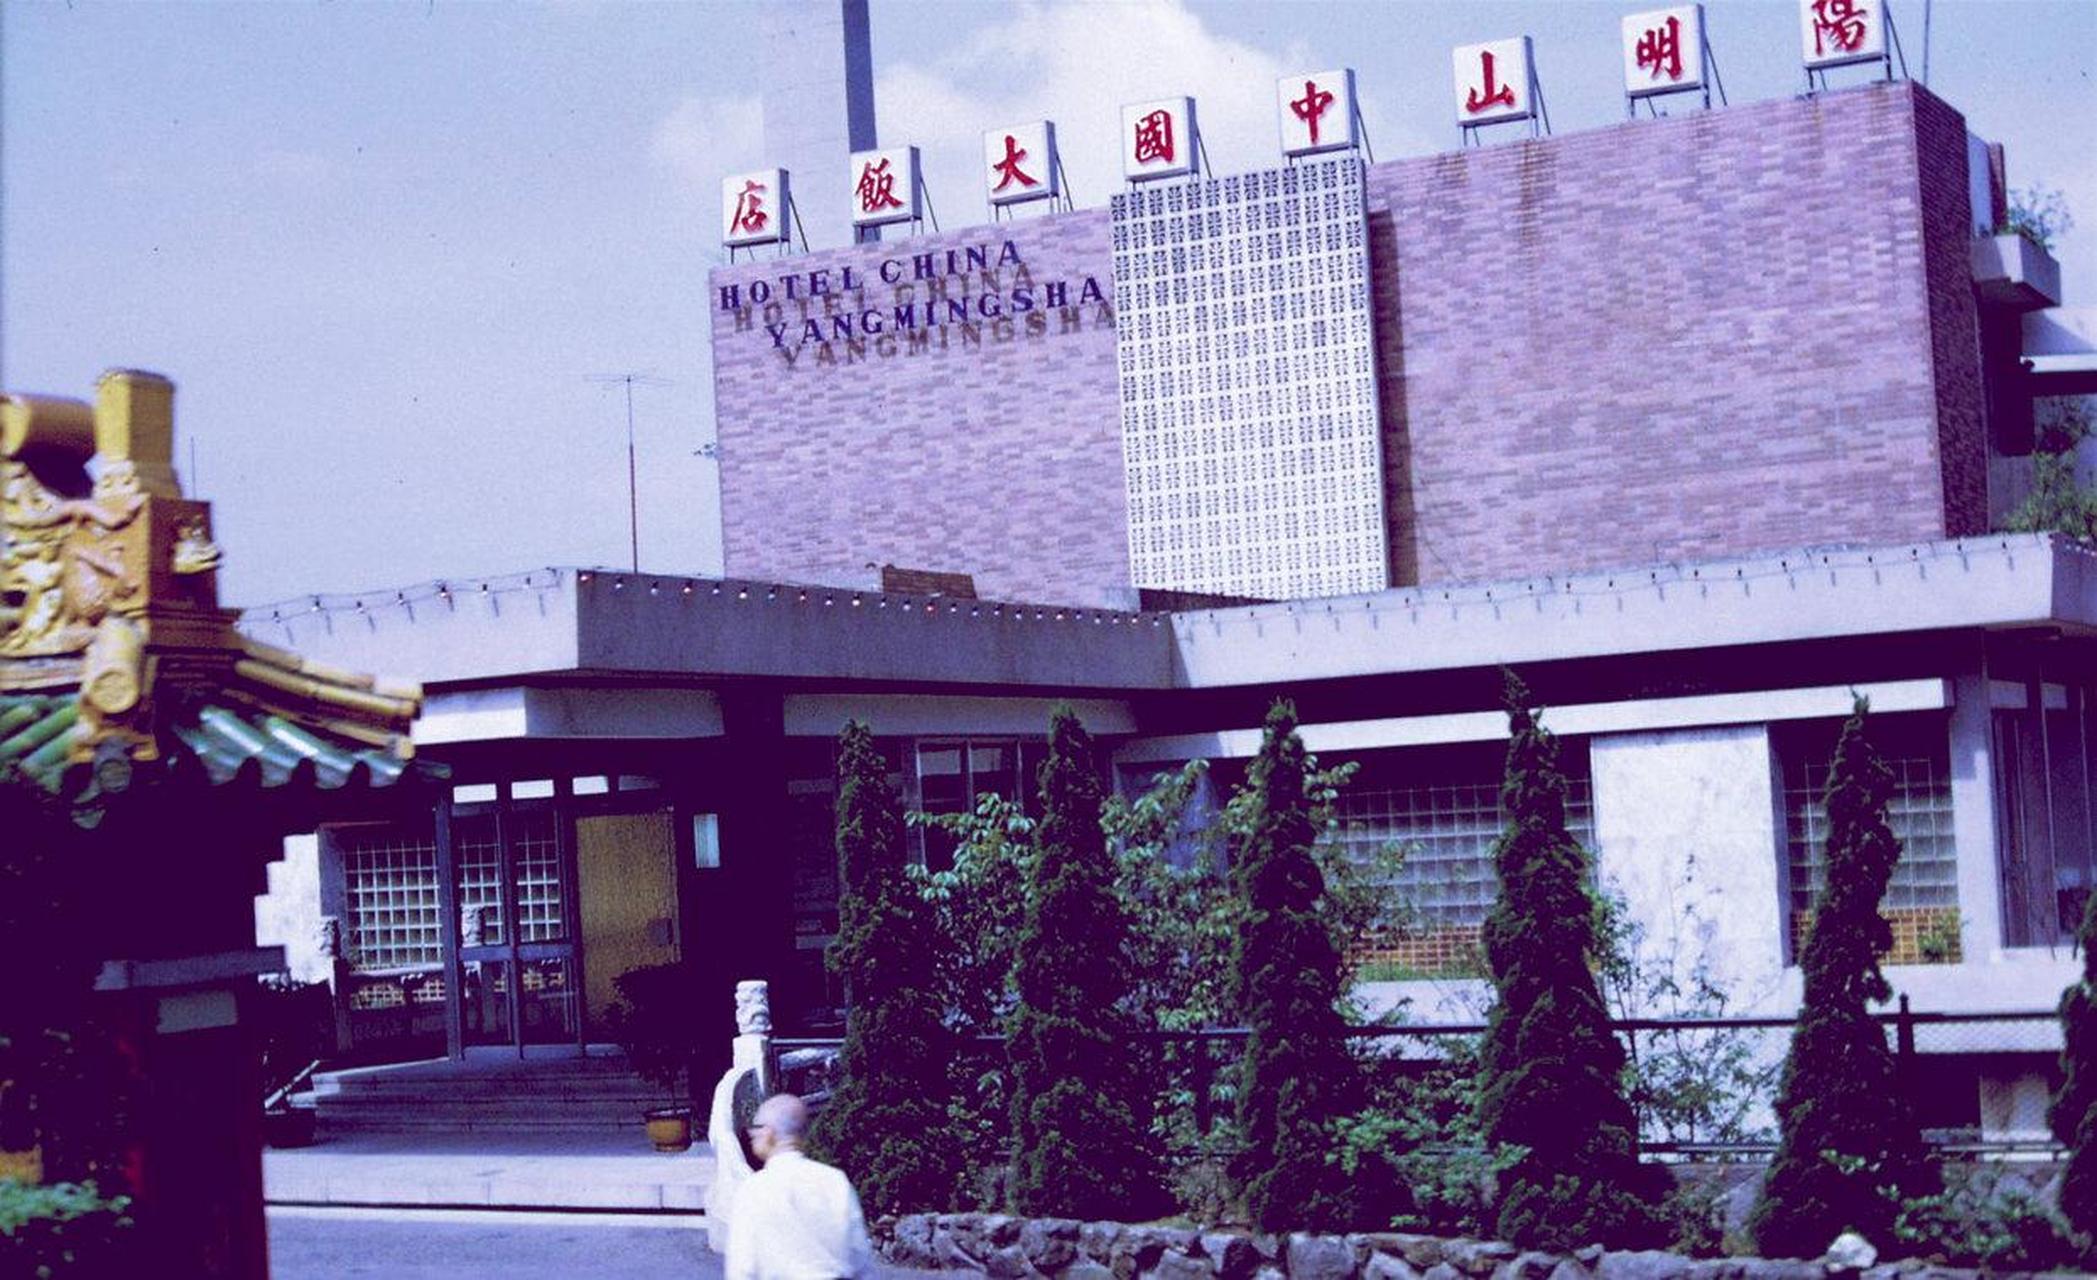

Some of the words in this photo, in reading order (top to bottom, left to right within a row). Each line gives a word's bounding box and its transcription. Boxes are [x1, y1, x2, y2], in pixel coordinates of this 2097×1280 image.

[719, 266, 863, 311] HOTEL
[878, 239, 1022, 285] CHINA
[766, 274, 1114, 348] YANGMINGSHA
